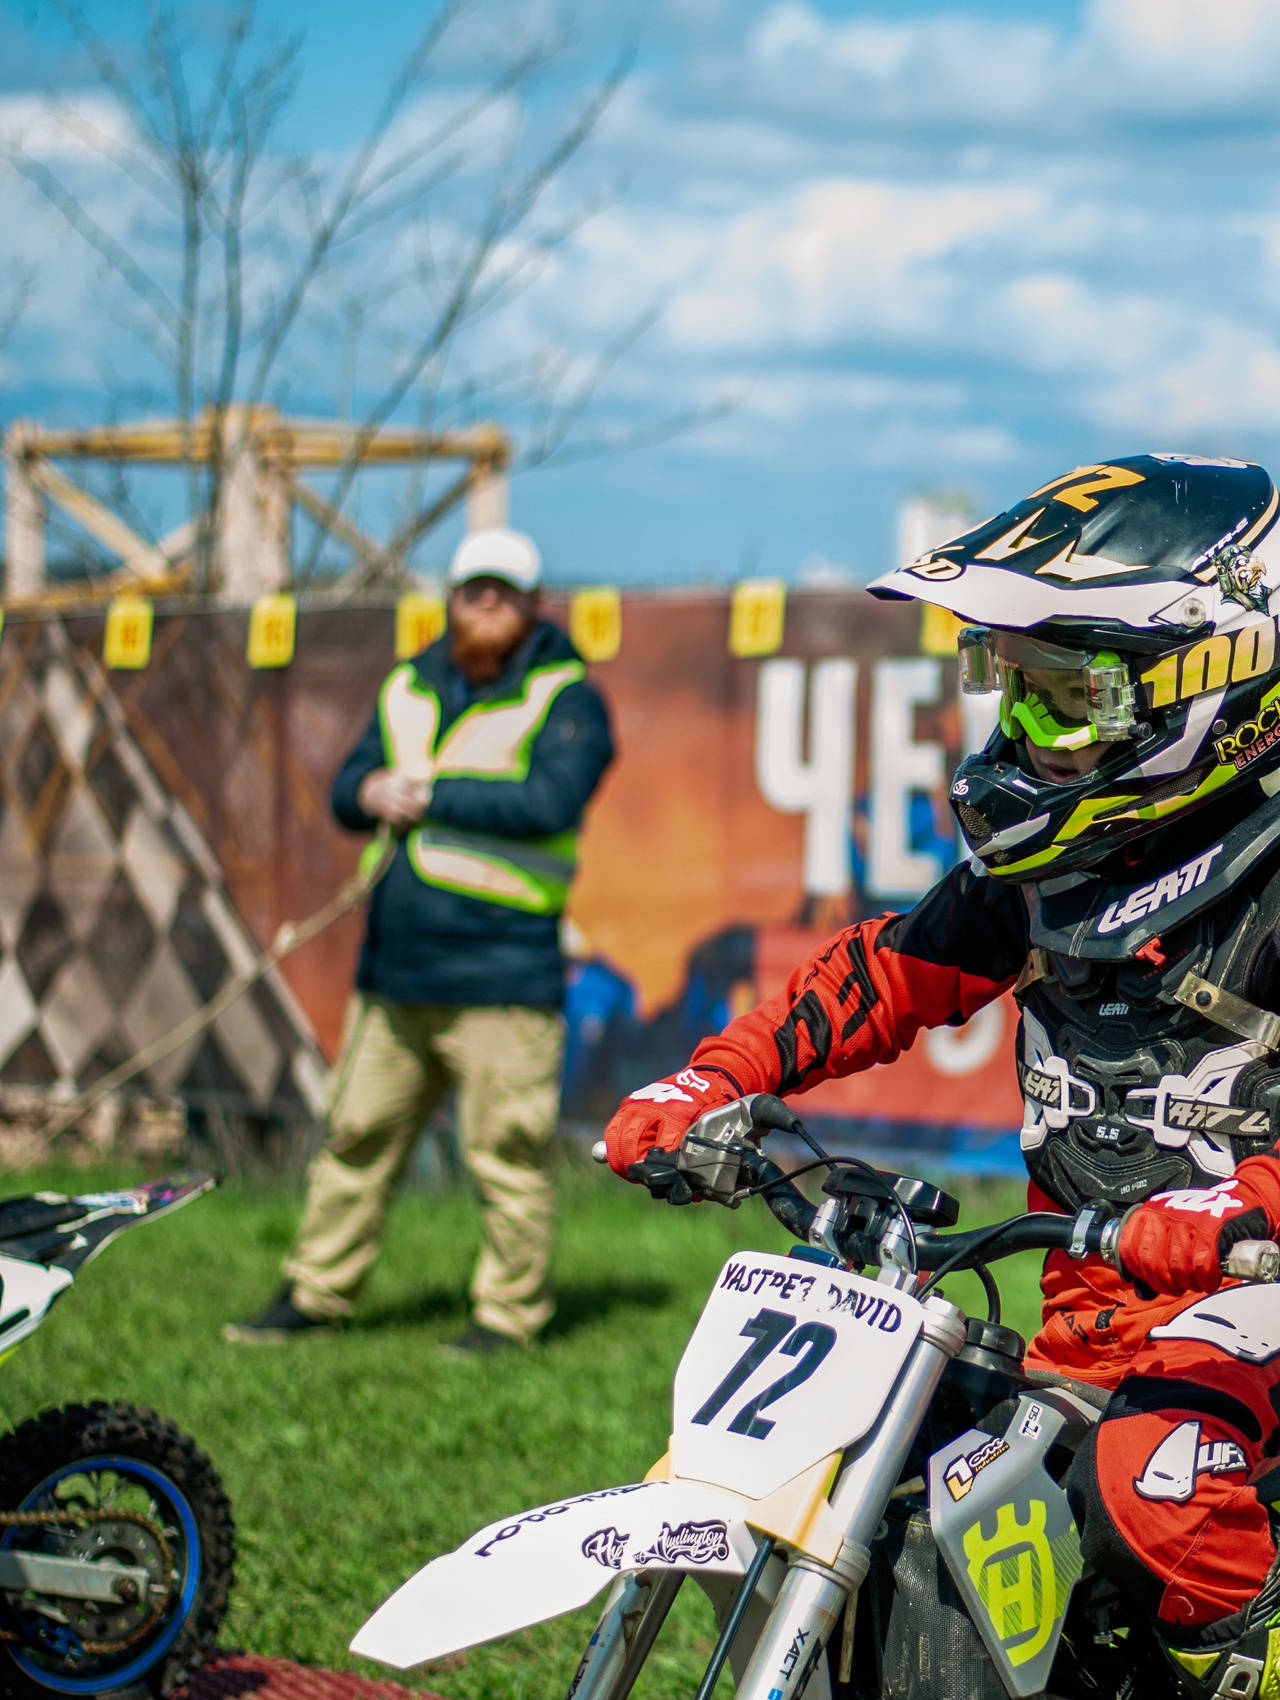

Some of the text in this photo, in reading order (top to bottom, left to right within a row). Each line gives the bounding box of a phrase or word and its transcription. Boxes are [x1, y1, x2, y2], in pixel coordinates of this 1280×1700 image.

[1097, 843, 1224, 934] LEATT
[1096, 1126, 1119, 1140] 5.5
[691, 1307, 839, 1440] 72
[779, 1627, 810, 1682] XACT
